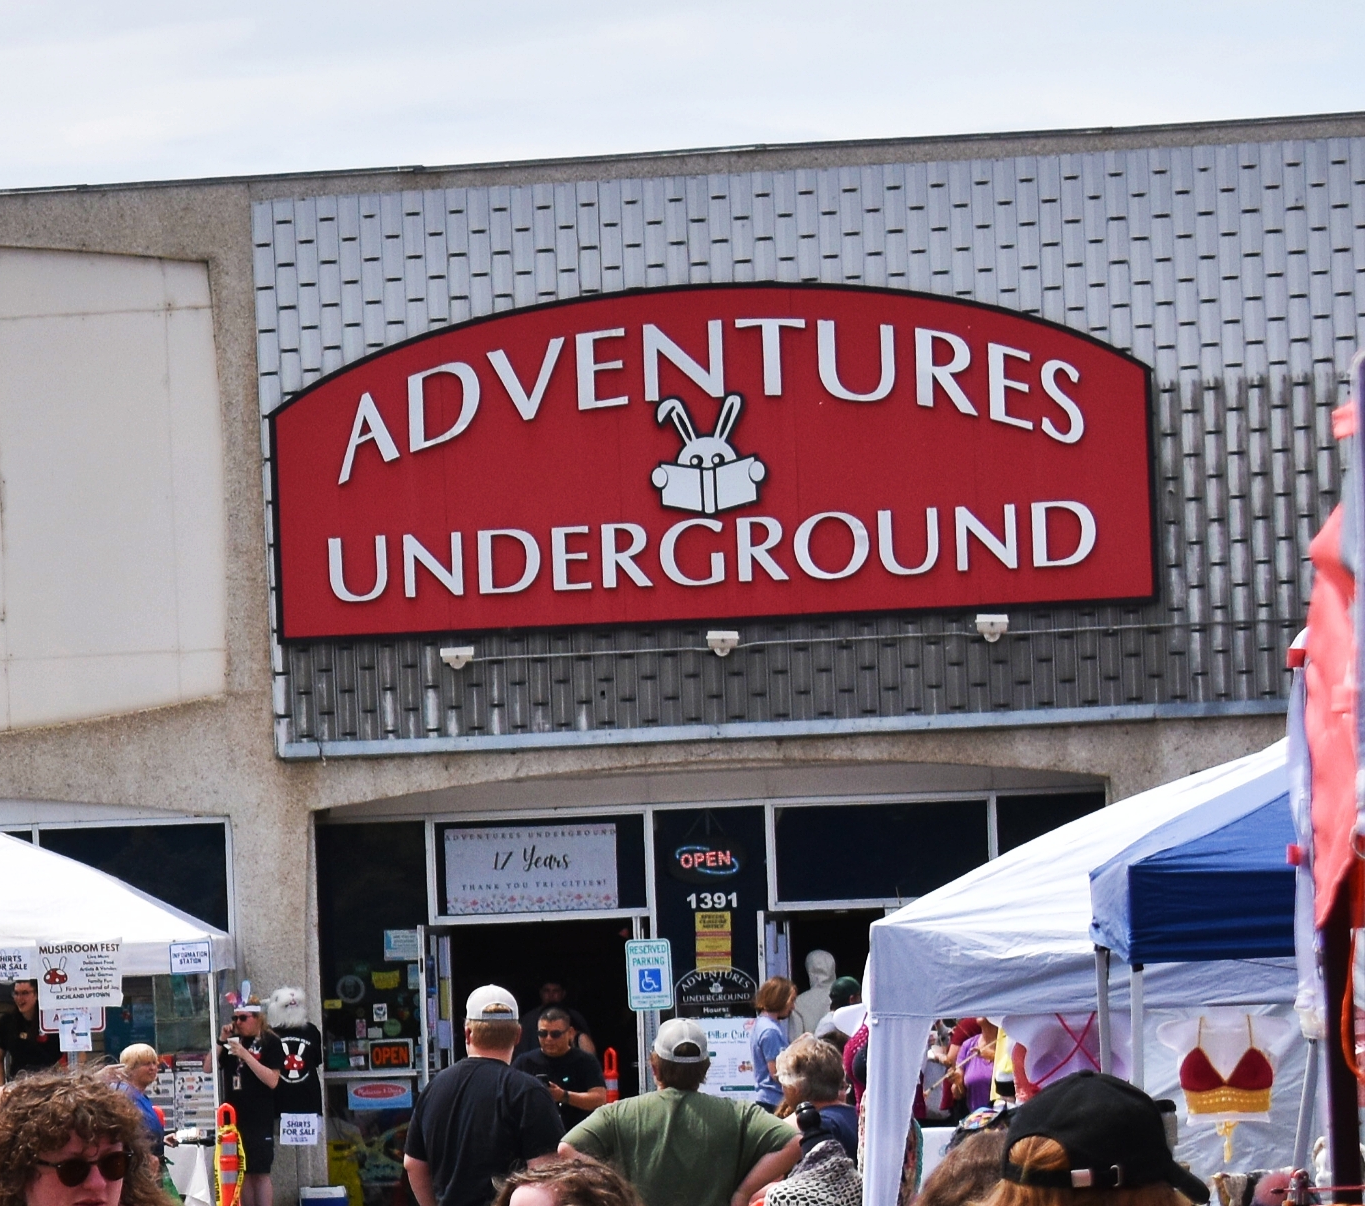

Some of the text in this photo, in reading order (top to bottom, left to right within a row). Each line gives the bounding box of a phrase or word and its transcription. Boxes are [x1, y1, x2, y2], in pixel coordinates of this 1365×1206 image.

[337, 318, 1085, 485] ADVENTURES
[327, 500, 1097, 603] UNDERGROUND
[445, 829, 617, 842] ADVENTURES UNDERGROUND
[492, 844, 570, 872] 17 Years
[680, 850, 731, 868] OPEN
[507, 882, 529, 890] YOU
[687, 892, 738, 909] 1391
[39, 944, 120, 954] MUSHROOM FEST
[173, 950, 208, 958] INFORMATION
[629, 944, 666, 954] RESERVED
[633, 957, 665, 966] PARKING
[9, 963, 27, 971] SALE
[681, 971, 751, 992] ADVENTURES
[683, 993, 751, 1002] UNDERGROUND
[703, 1006, 729, 1014] Hours:
[372, 1046, 409, 1065] OPEN
[287, 1120, 311, 1128] SHIRTS
[282, 1128, 315, 1136] FOR SALE
